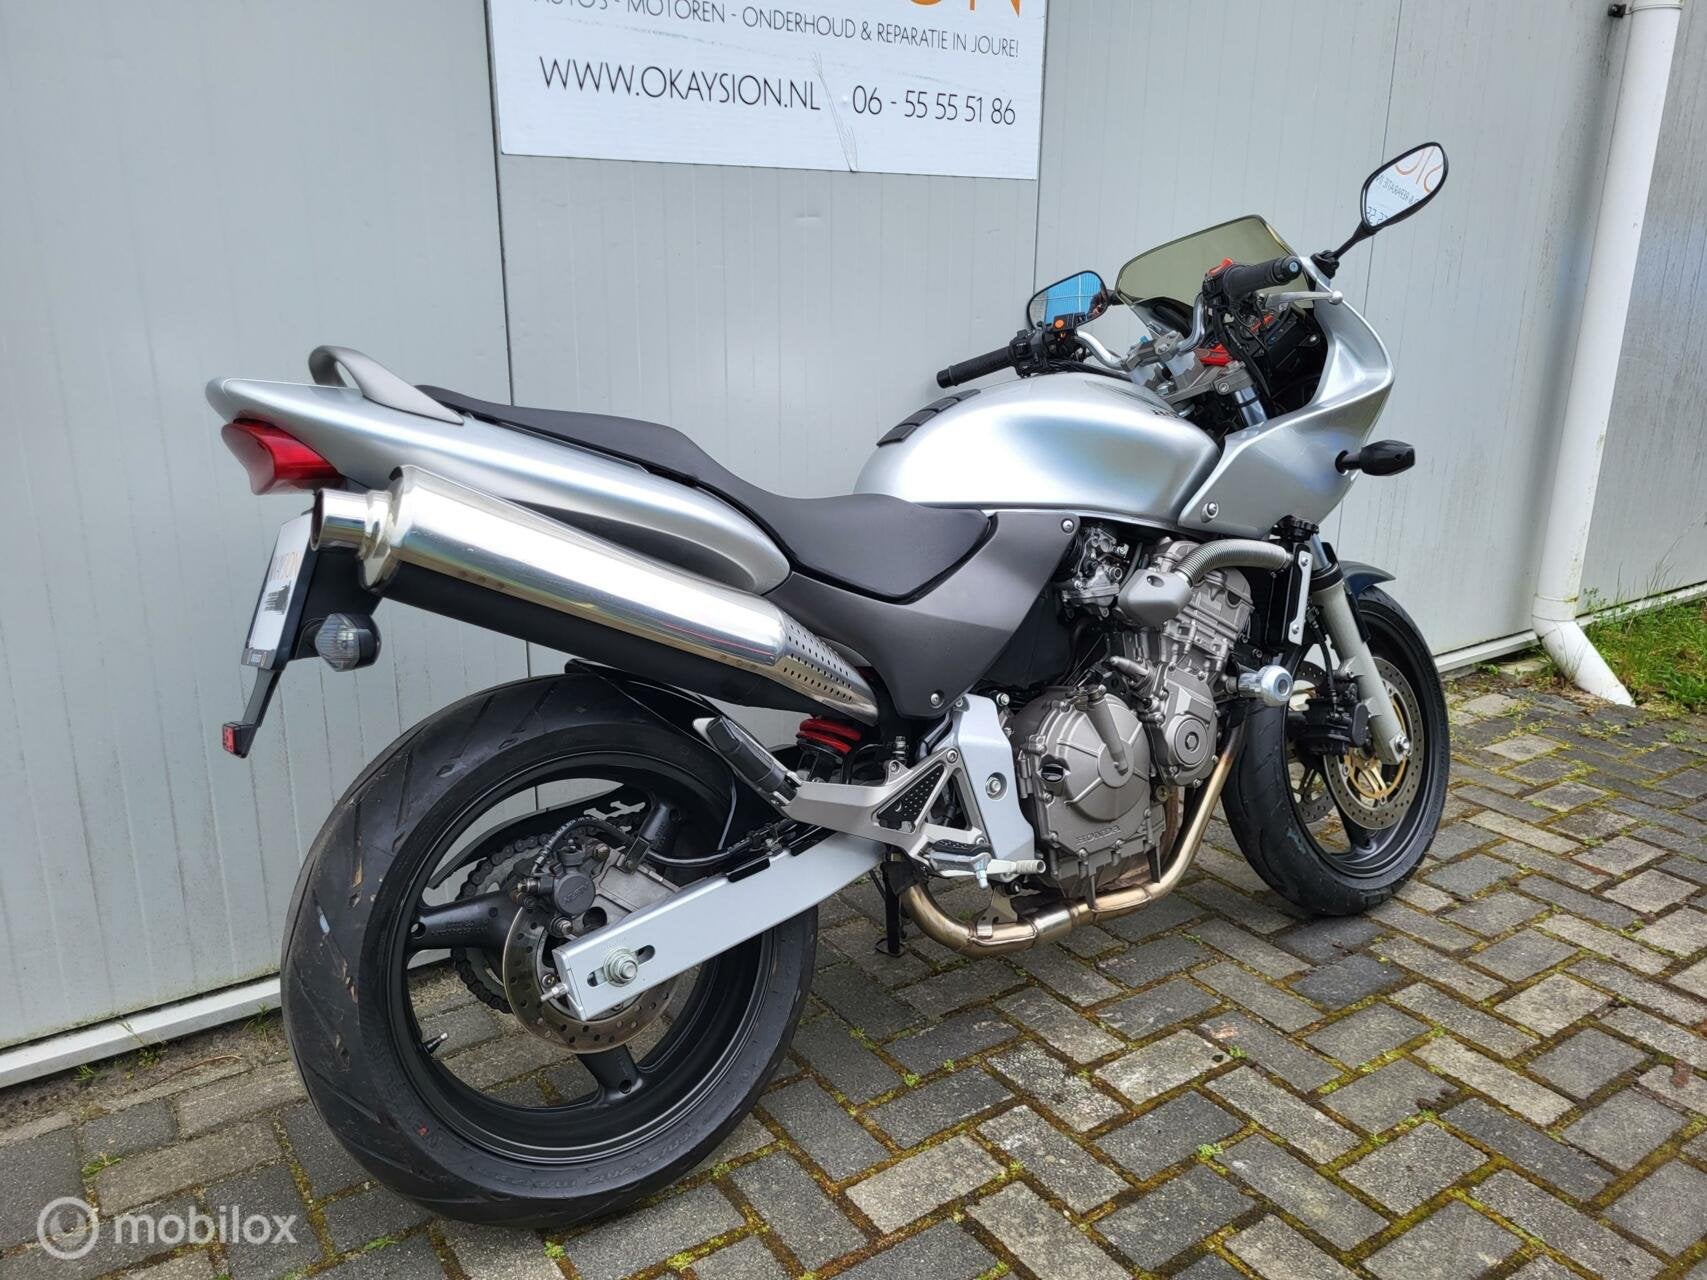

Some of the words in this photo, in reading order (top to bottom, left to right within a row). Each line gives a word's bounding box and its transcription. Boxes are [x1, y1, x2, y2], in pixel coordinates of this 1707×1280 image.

[627, 0, 725, 23] MOTOREN
[742, 6, 856, 38] ONDERHOUD
[861, 21, 872, 41] &
[877, 22, 948, 50] REPARATIE
[953, 32, 967, 52] IN
[971, 35, 1019, 58] JOURE!
[538, 56, 821, 111] WWW.OKAYSION.NL
[852, 85, 883, 115] 06
[904, 90, 928, 118] 55
[935, 93, 958, 121] 55
[964, 95, 983, 123] 51
[990, 97, 1016, 125] 86
